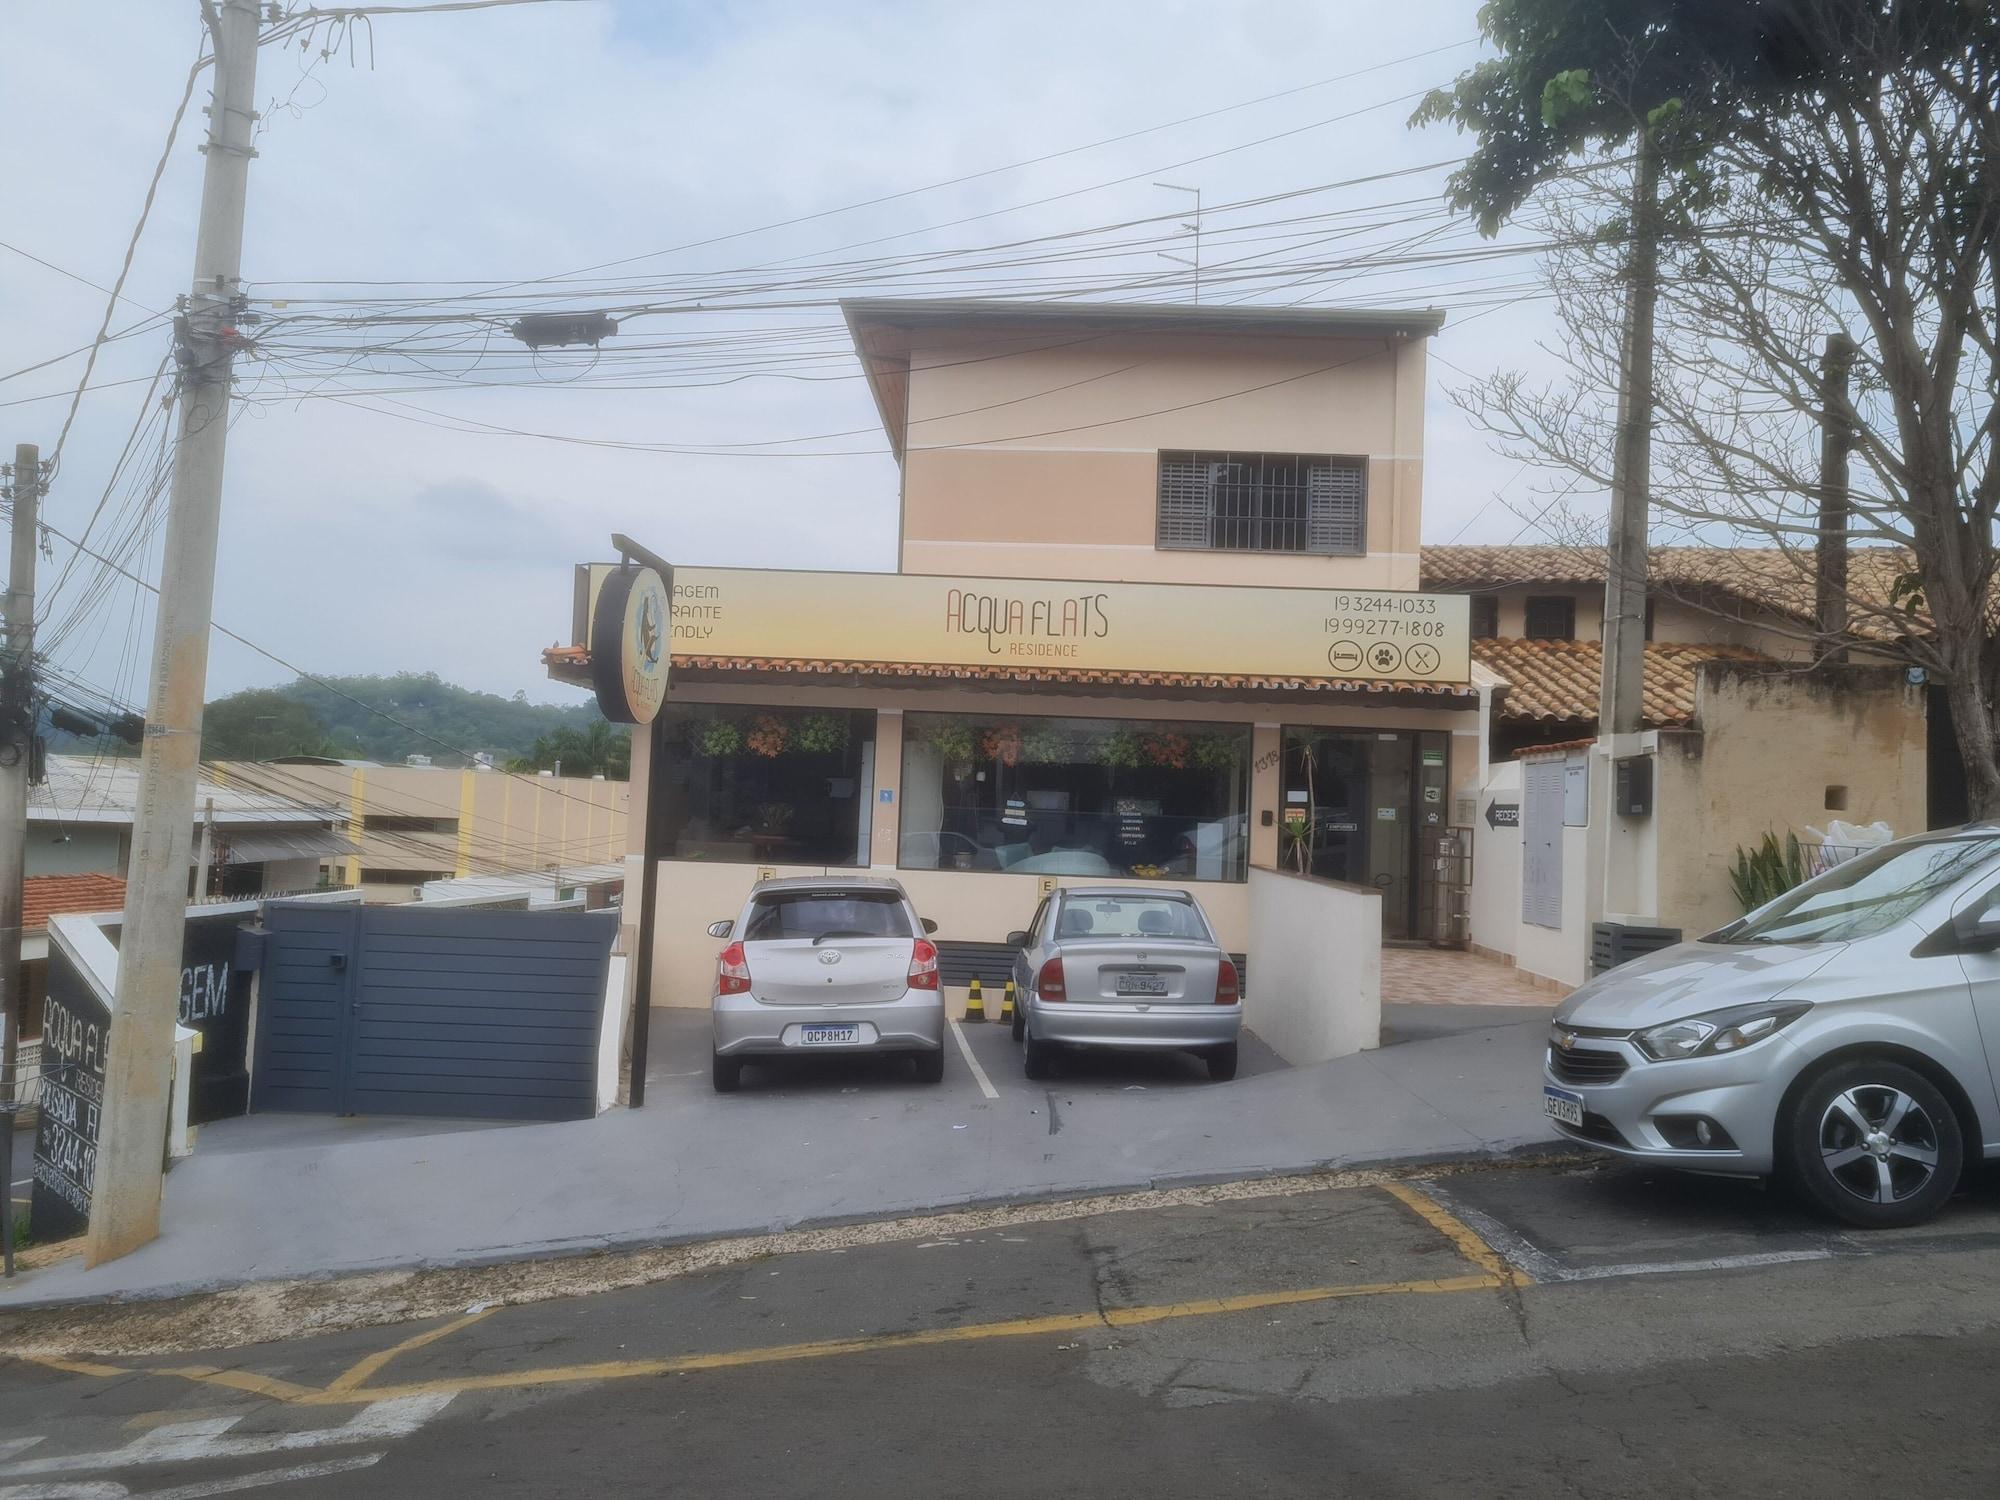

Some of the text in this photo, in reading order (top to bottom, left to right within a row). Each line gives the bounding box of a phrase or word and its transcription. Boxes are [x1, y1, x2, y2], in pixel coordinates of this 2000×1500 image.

[673, 584, 719, 598] AGEM
[671, 604, 722, 619] RANTE
[1335, 595, 1436, 614] 19 3244-1033
[946, 588, 1109, 654] ACQUA FLATS
[1324, 618, 1445, 637] 19 99277-1808
[1009, 642, 1078, 657] RESIDENCE
[1495, 809, 1519, 822] RECEP
[1044, 881, 1052, 891] E
[176, 961, 229, 1024] GEM
[807, 1030, 853, 1042] QCP8H17
[50, 1123, 96, 1192] 3244-10
